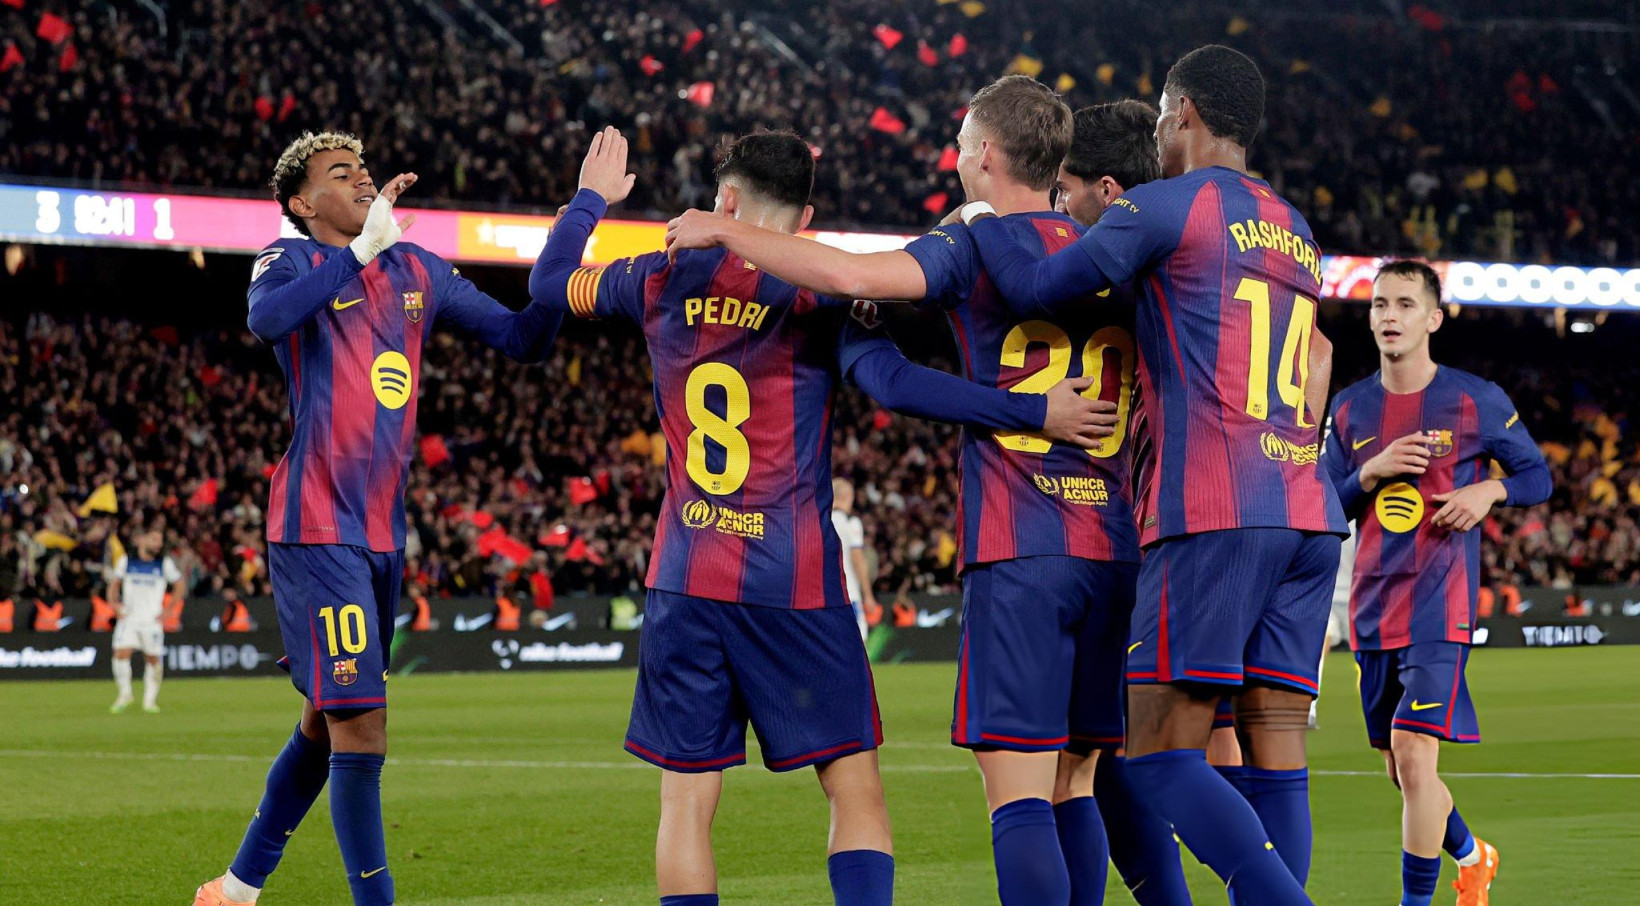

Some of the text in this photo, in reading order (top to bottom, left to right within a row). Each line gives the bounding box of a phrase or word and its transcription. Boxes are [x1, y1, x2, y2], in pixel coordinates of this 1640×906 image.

[153, 198, 174, 240] 1
[685, 297, 770, 331] PEDRI
[1233, 277, 1316, 428] 14
[994, 320, 1135, 458] 20
[685, 362, 751, 496] 8
[1061, 477, 1106, 490] UNHCR
[1063, 489, 1108, 500] ACNUR
[319, 604, 367, 657] 10
